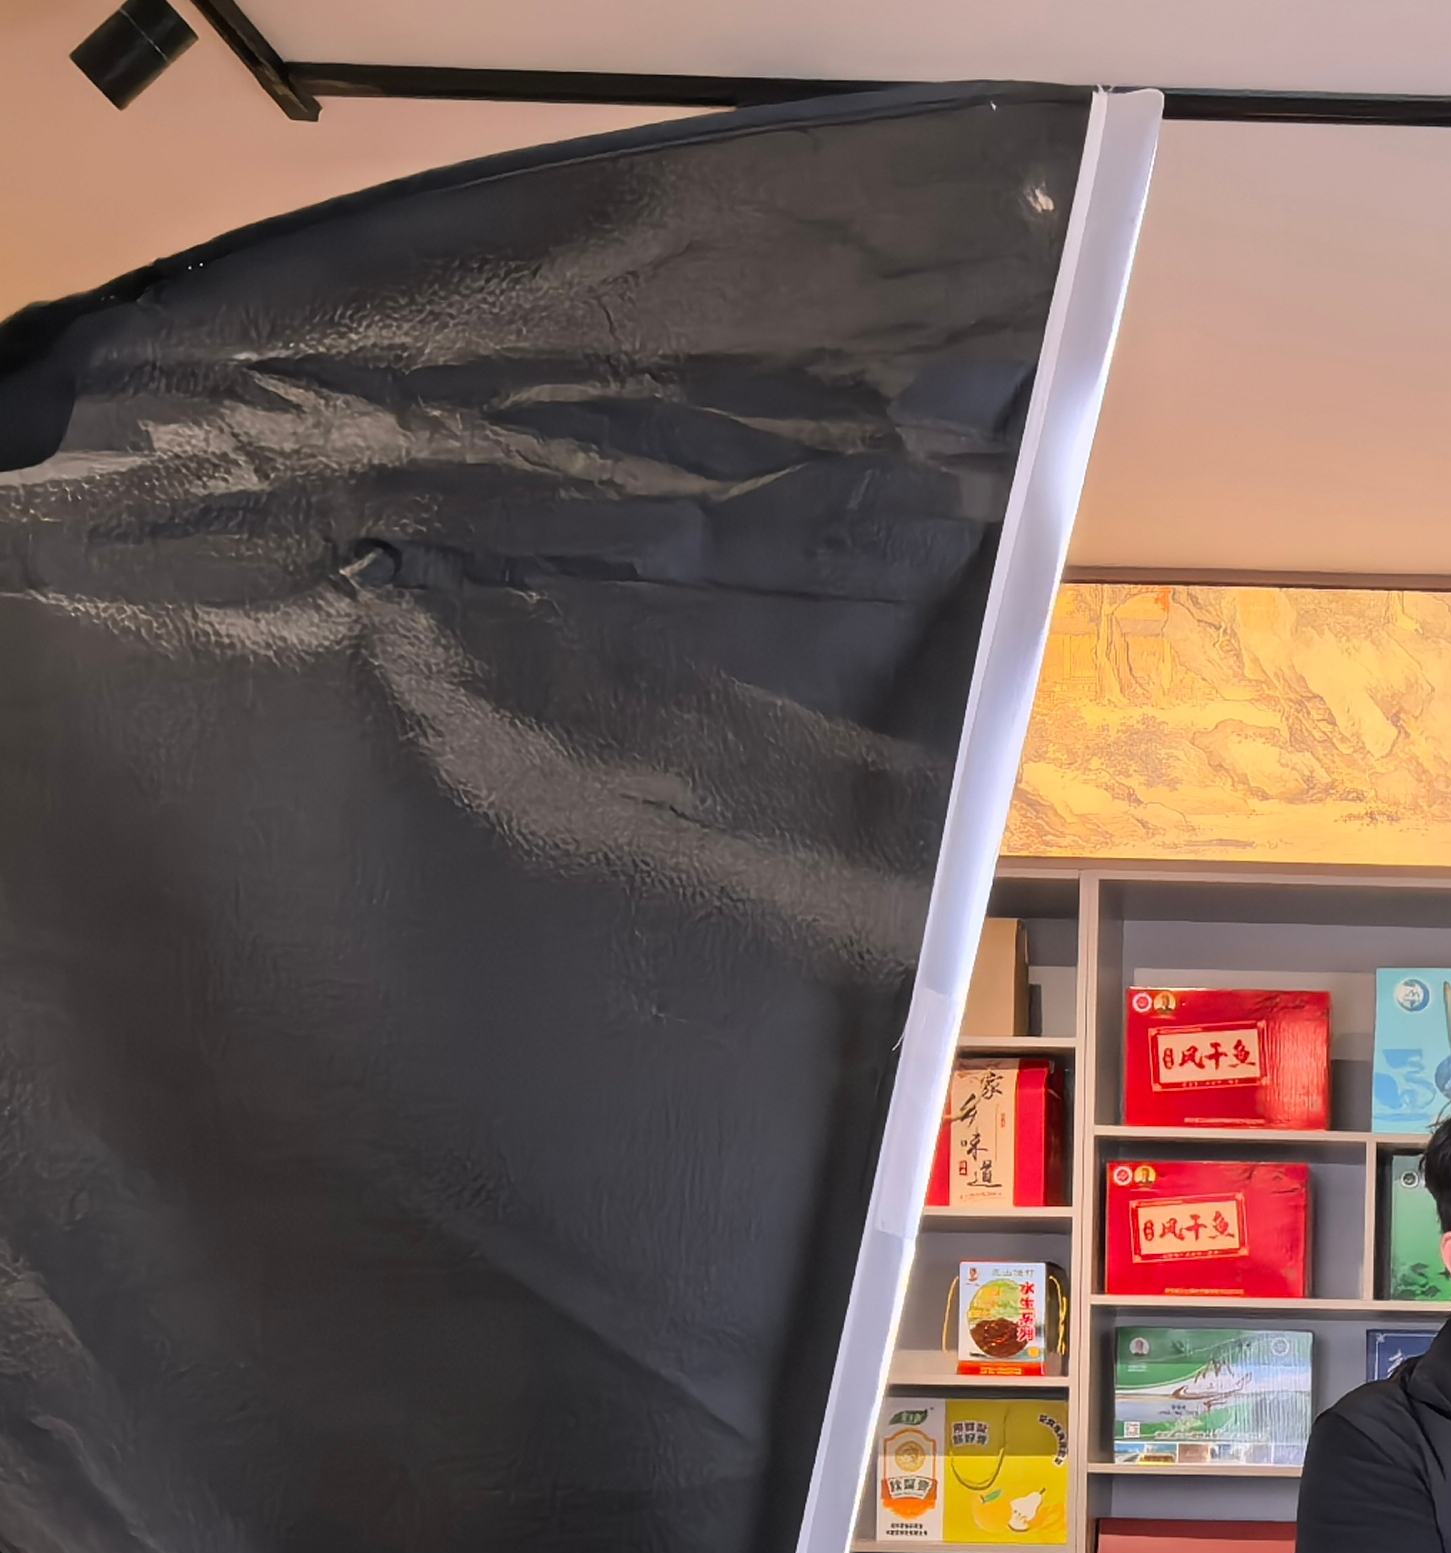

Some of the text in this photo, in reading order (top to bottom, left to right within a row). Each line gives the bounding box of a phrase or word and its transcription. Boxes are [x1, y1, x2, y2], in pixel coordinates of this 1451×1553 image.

[1179, 1039, 1256, 1070] 风干鱼
[951, 1071, 1003, 1188] 家乡味道
[1159, 1211, 1235, 1241] 风干鱼
